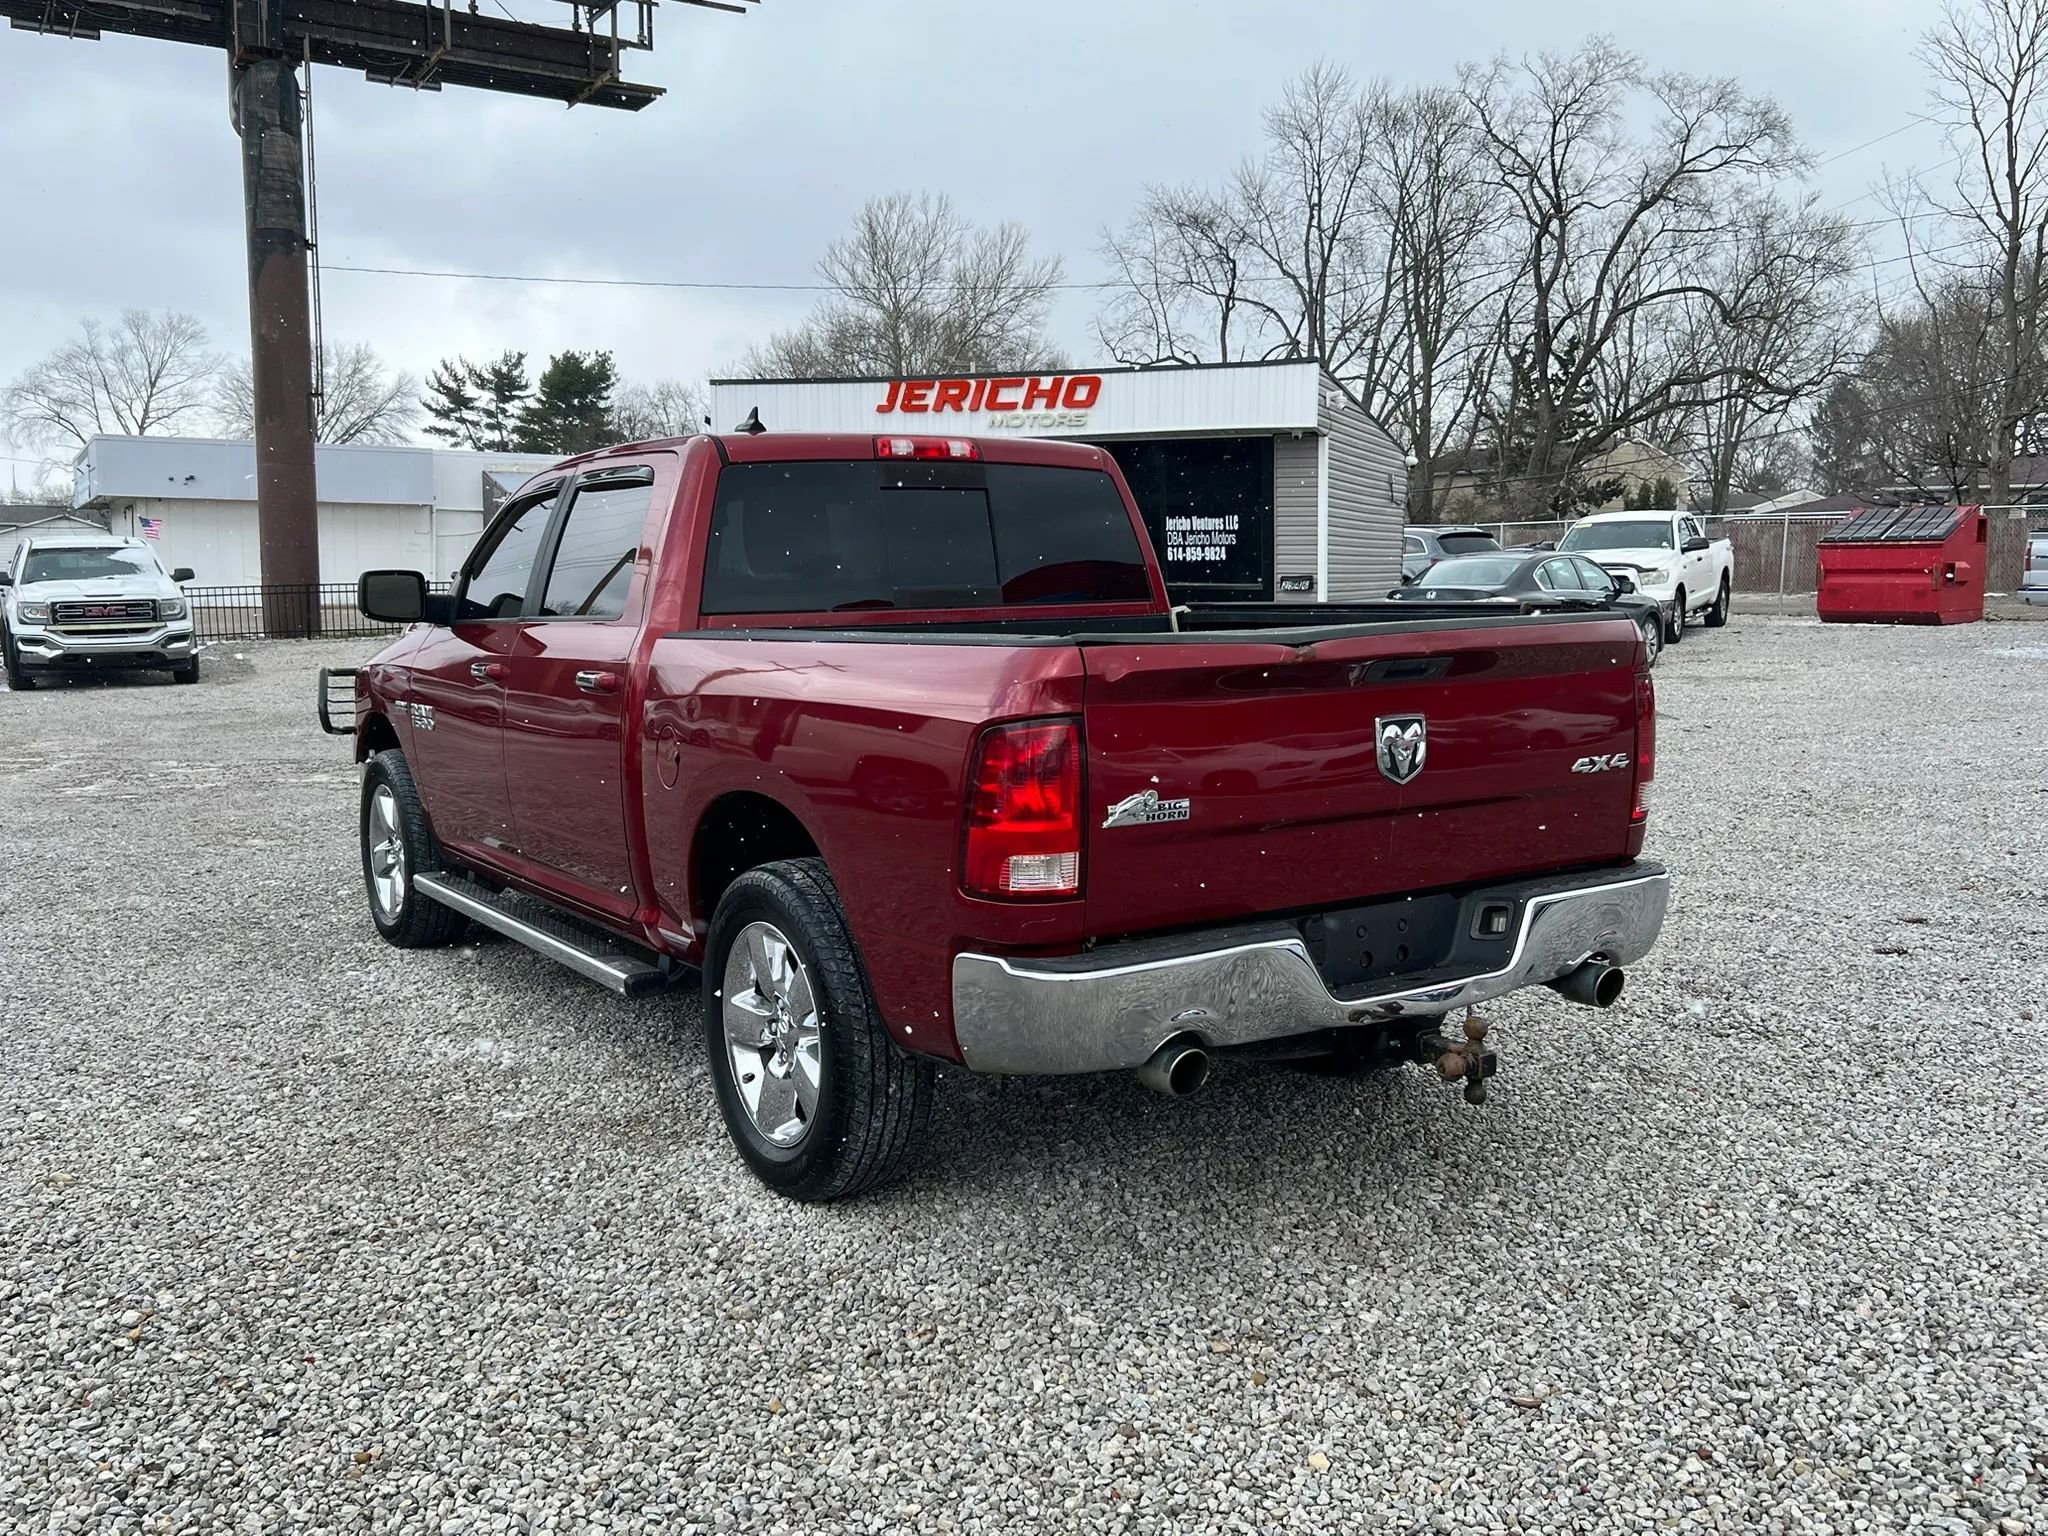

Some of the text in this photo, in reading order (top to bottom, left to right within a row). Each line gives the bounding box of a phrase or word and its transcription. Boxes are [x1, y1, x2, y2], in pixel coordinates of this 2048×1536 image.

[876, 375, 1102, 413] JERICHO
[988, 412, 1088, 428] MOTORS
[1165, 514, 1239, 531] Jericho Ventures LLC
[1167, 531, 1237, 546] DBA Jericho Motors
[1167, 546, 1227, 561] 614-859-9824
[84, 605, 126, 616] GMC
[1157, 801, 1184, 812] BIG
[1145, 810, 1188, 822] HORN
